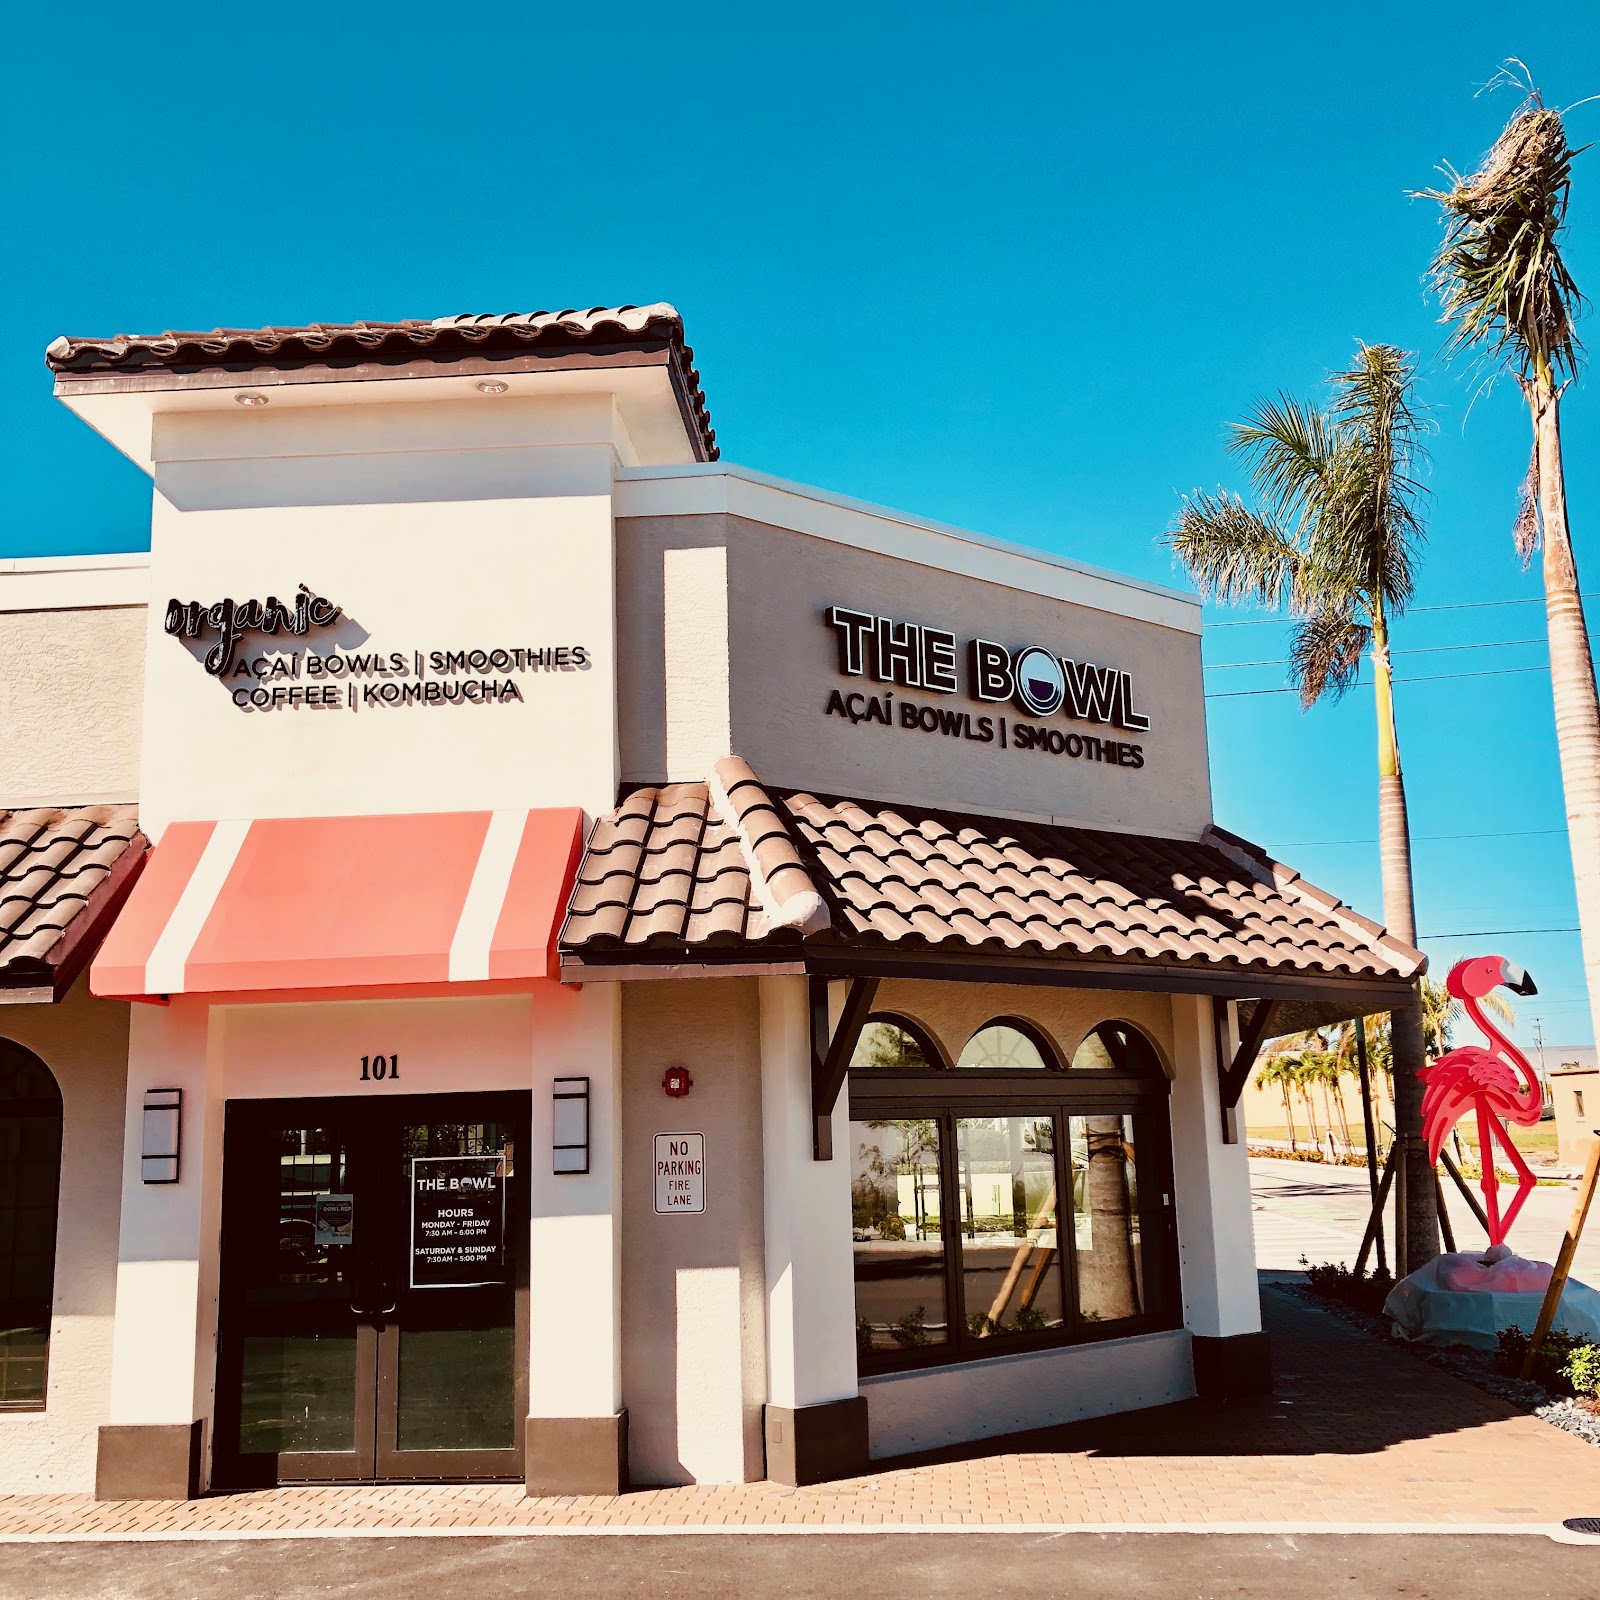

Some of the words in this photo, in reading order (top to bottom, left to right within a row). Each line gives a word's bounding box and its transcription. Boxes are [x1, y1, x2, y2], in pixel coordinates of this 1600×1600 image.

[164, 583, 343, 678] organic
[232, 652, 300, 680] AÇAÍ
[306, 651, 405, 676] BOWLS
[430, 646, 587, 671] SMOOTHIES
[824, 605, 958, 694] THE
[968, 638, 1151, 732] BOWL
[231, 685, 338, 708] COFFEE
[363, 679, 519, 703] KOMBUCHA
[826, 689, 895, 726] AÇAÍ
[901, 702, 994, 743] BOWLS
[1014, 724, 1145, 769] SMOOTHIES
[360, 1054, 400, 1081] 101
[669, 1141, 689, 1156] NO
[657, 1160, 701, 1176] PARKING
[417, 1179, 446, 1190] THE
[450, 1177, 496, 1190] BOWL
[669, 1180, 690, 1191] FIRE
[667, 1195, 692, 1206] LANE
[438, 1209, 474, 1218] HOURS
[421, 1221, 455, 1229] MONDAY
[415, 1247, 456, 1255] SATURDAY
[458, 1246, 463, 1254] &
